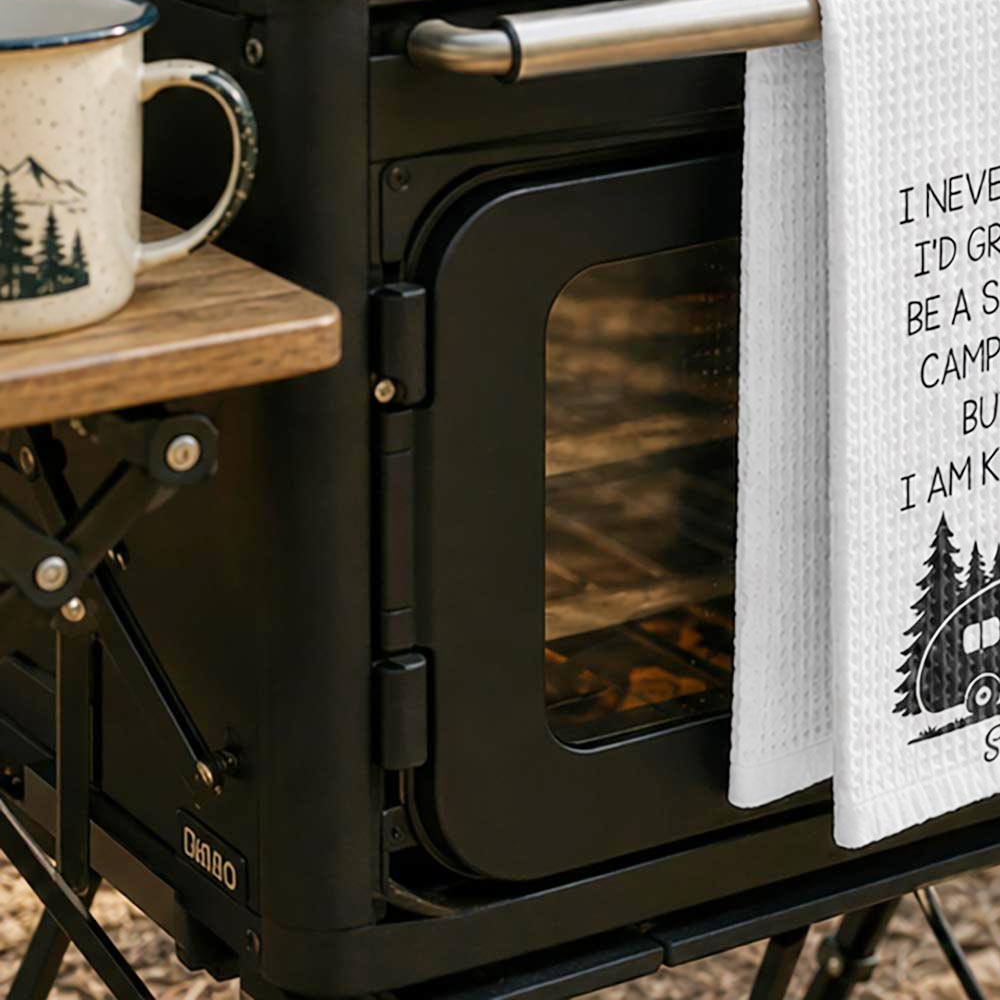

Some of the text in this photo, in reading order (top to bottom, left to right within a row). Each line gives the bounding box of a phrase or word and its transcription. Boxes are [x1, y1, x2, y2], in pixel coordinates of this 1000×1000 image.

[899, 186, 915, 225] I
[914, 236, 957, 278] I'D
[907, 294, 941, 337] BE
[951, 288, 972, 326] A
[900, 473, 916, 512] I
[927, 455, 972, 504] AM
